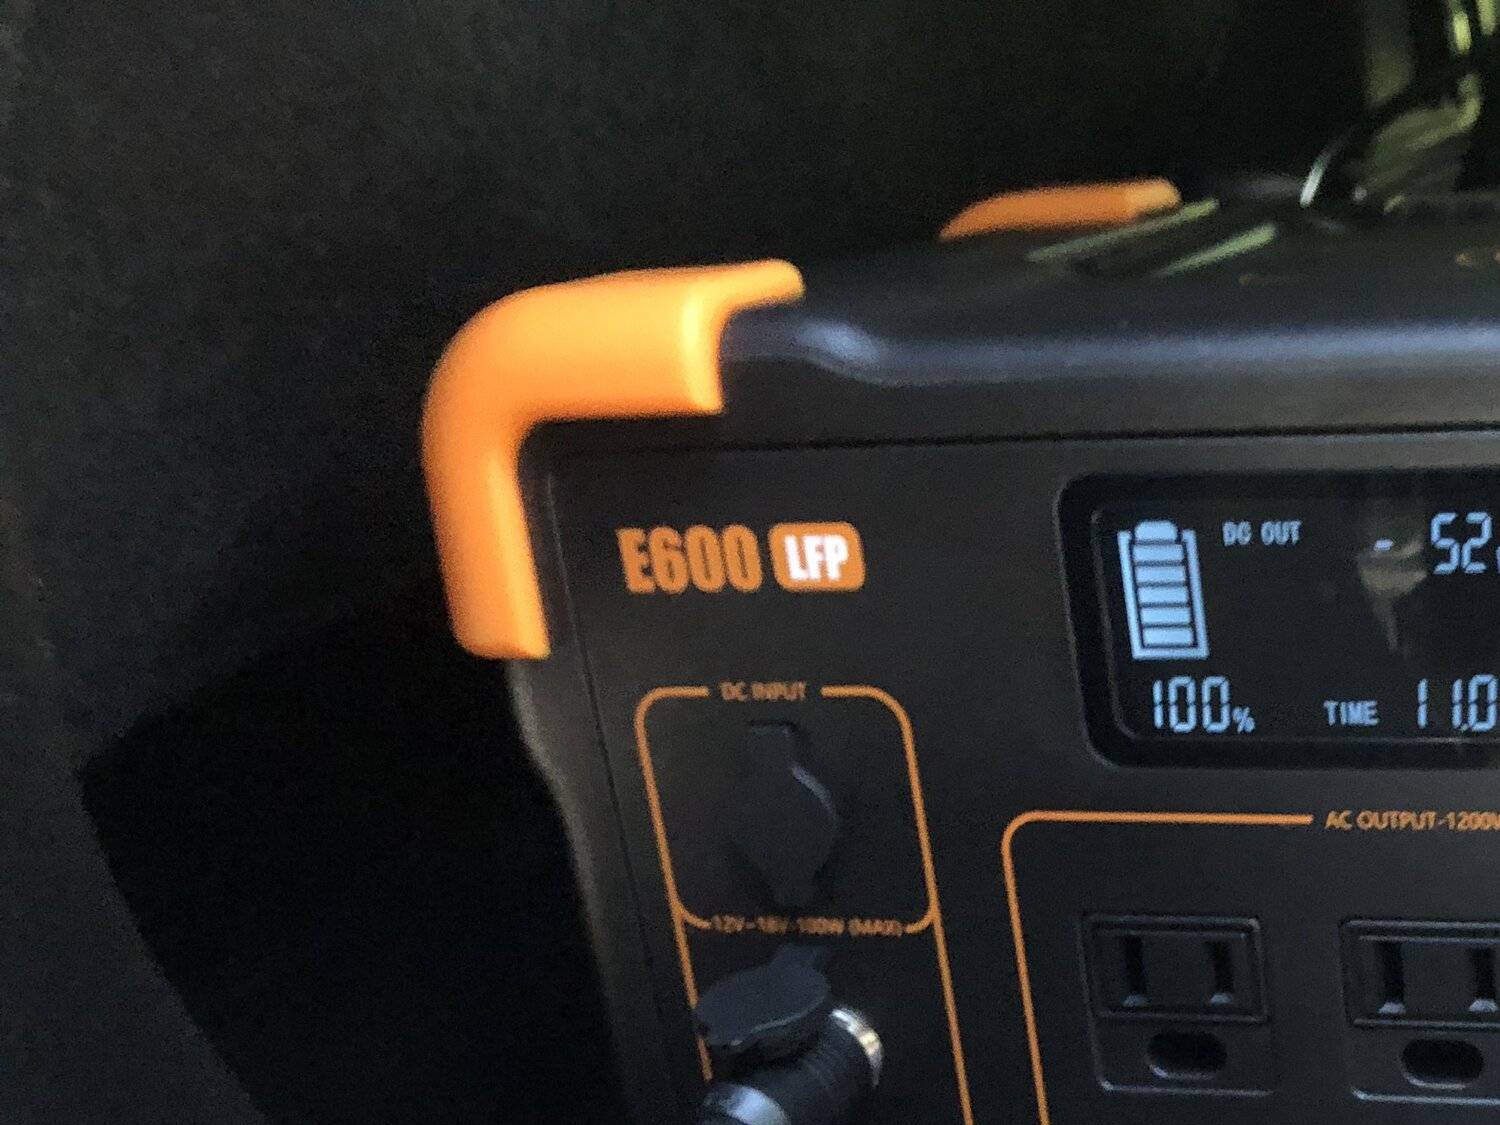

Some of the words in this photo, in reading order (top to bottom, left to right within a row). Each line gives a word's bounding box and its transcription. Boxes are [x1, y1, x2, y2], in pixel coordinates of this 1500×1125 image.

[1260, 519, 1303, 546] OUT
[617, 525, 763, 594] E600
[783, 533, 850, 581] LFP
[719, 680, 748, 702] DC
[751, 681, 807, 702] INPUT
[1323, 700, 1379, 728] TIME
[1324, 809, 1352, 831] AC
